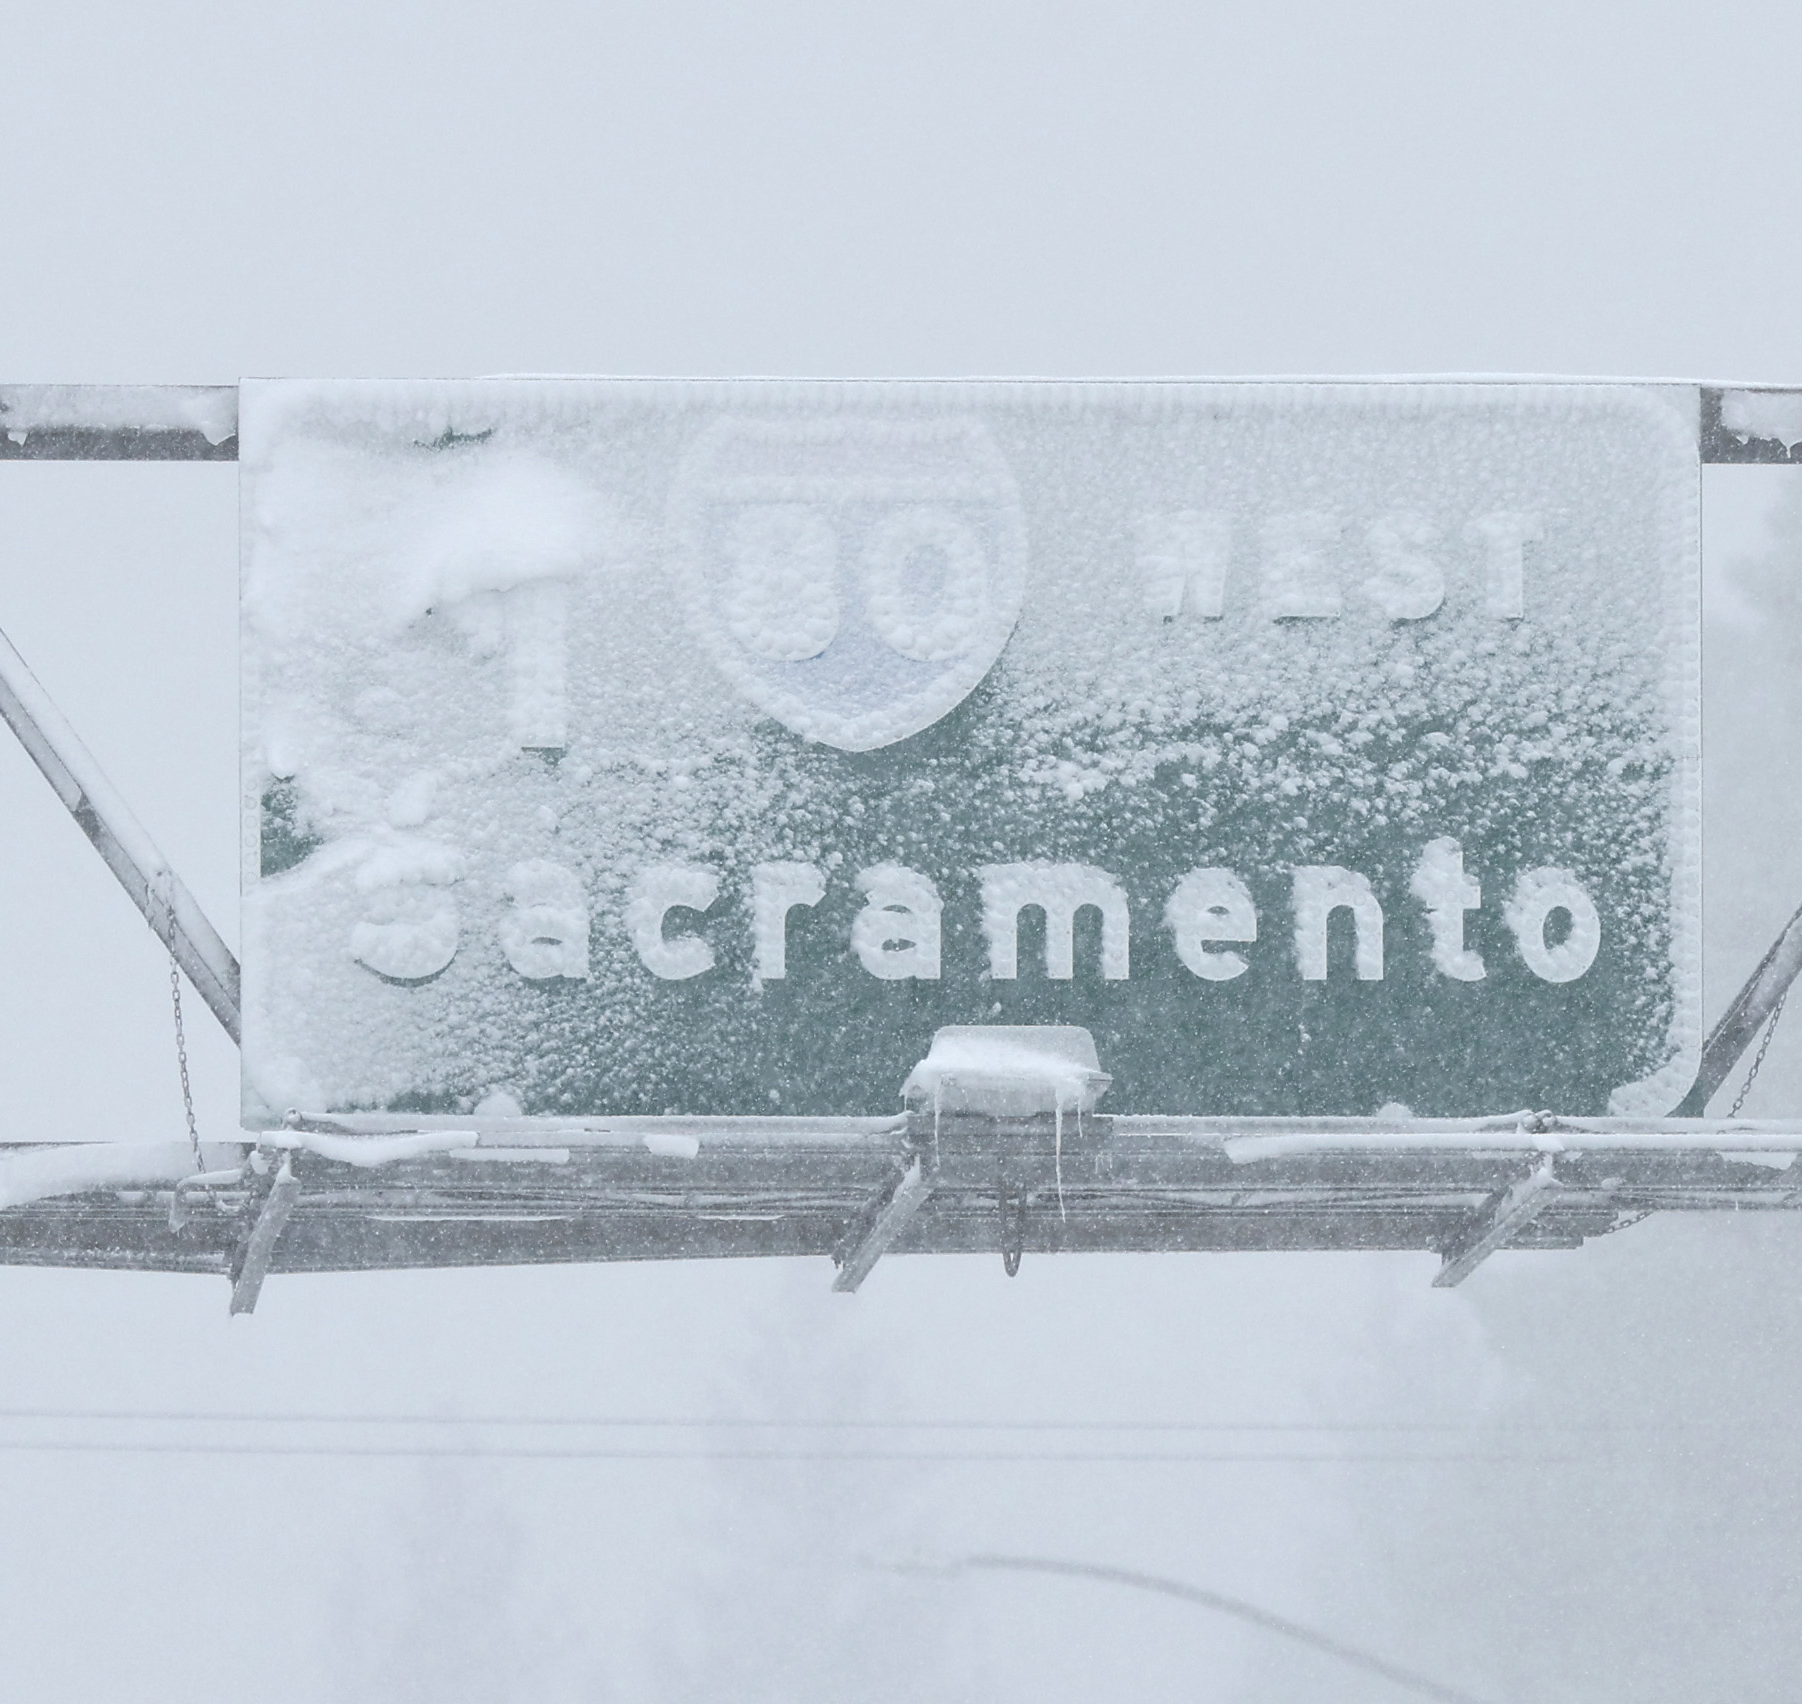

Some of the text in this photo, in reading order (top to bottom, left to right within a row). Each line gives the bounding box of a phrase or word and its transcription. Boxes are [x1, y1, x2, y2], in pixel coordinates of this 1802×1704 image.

[727, 507, 1543, 661] 80 WEST
[350, 836, 1601, 985] Sacramento
